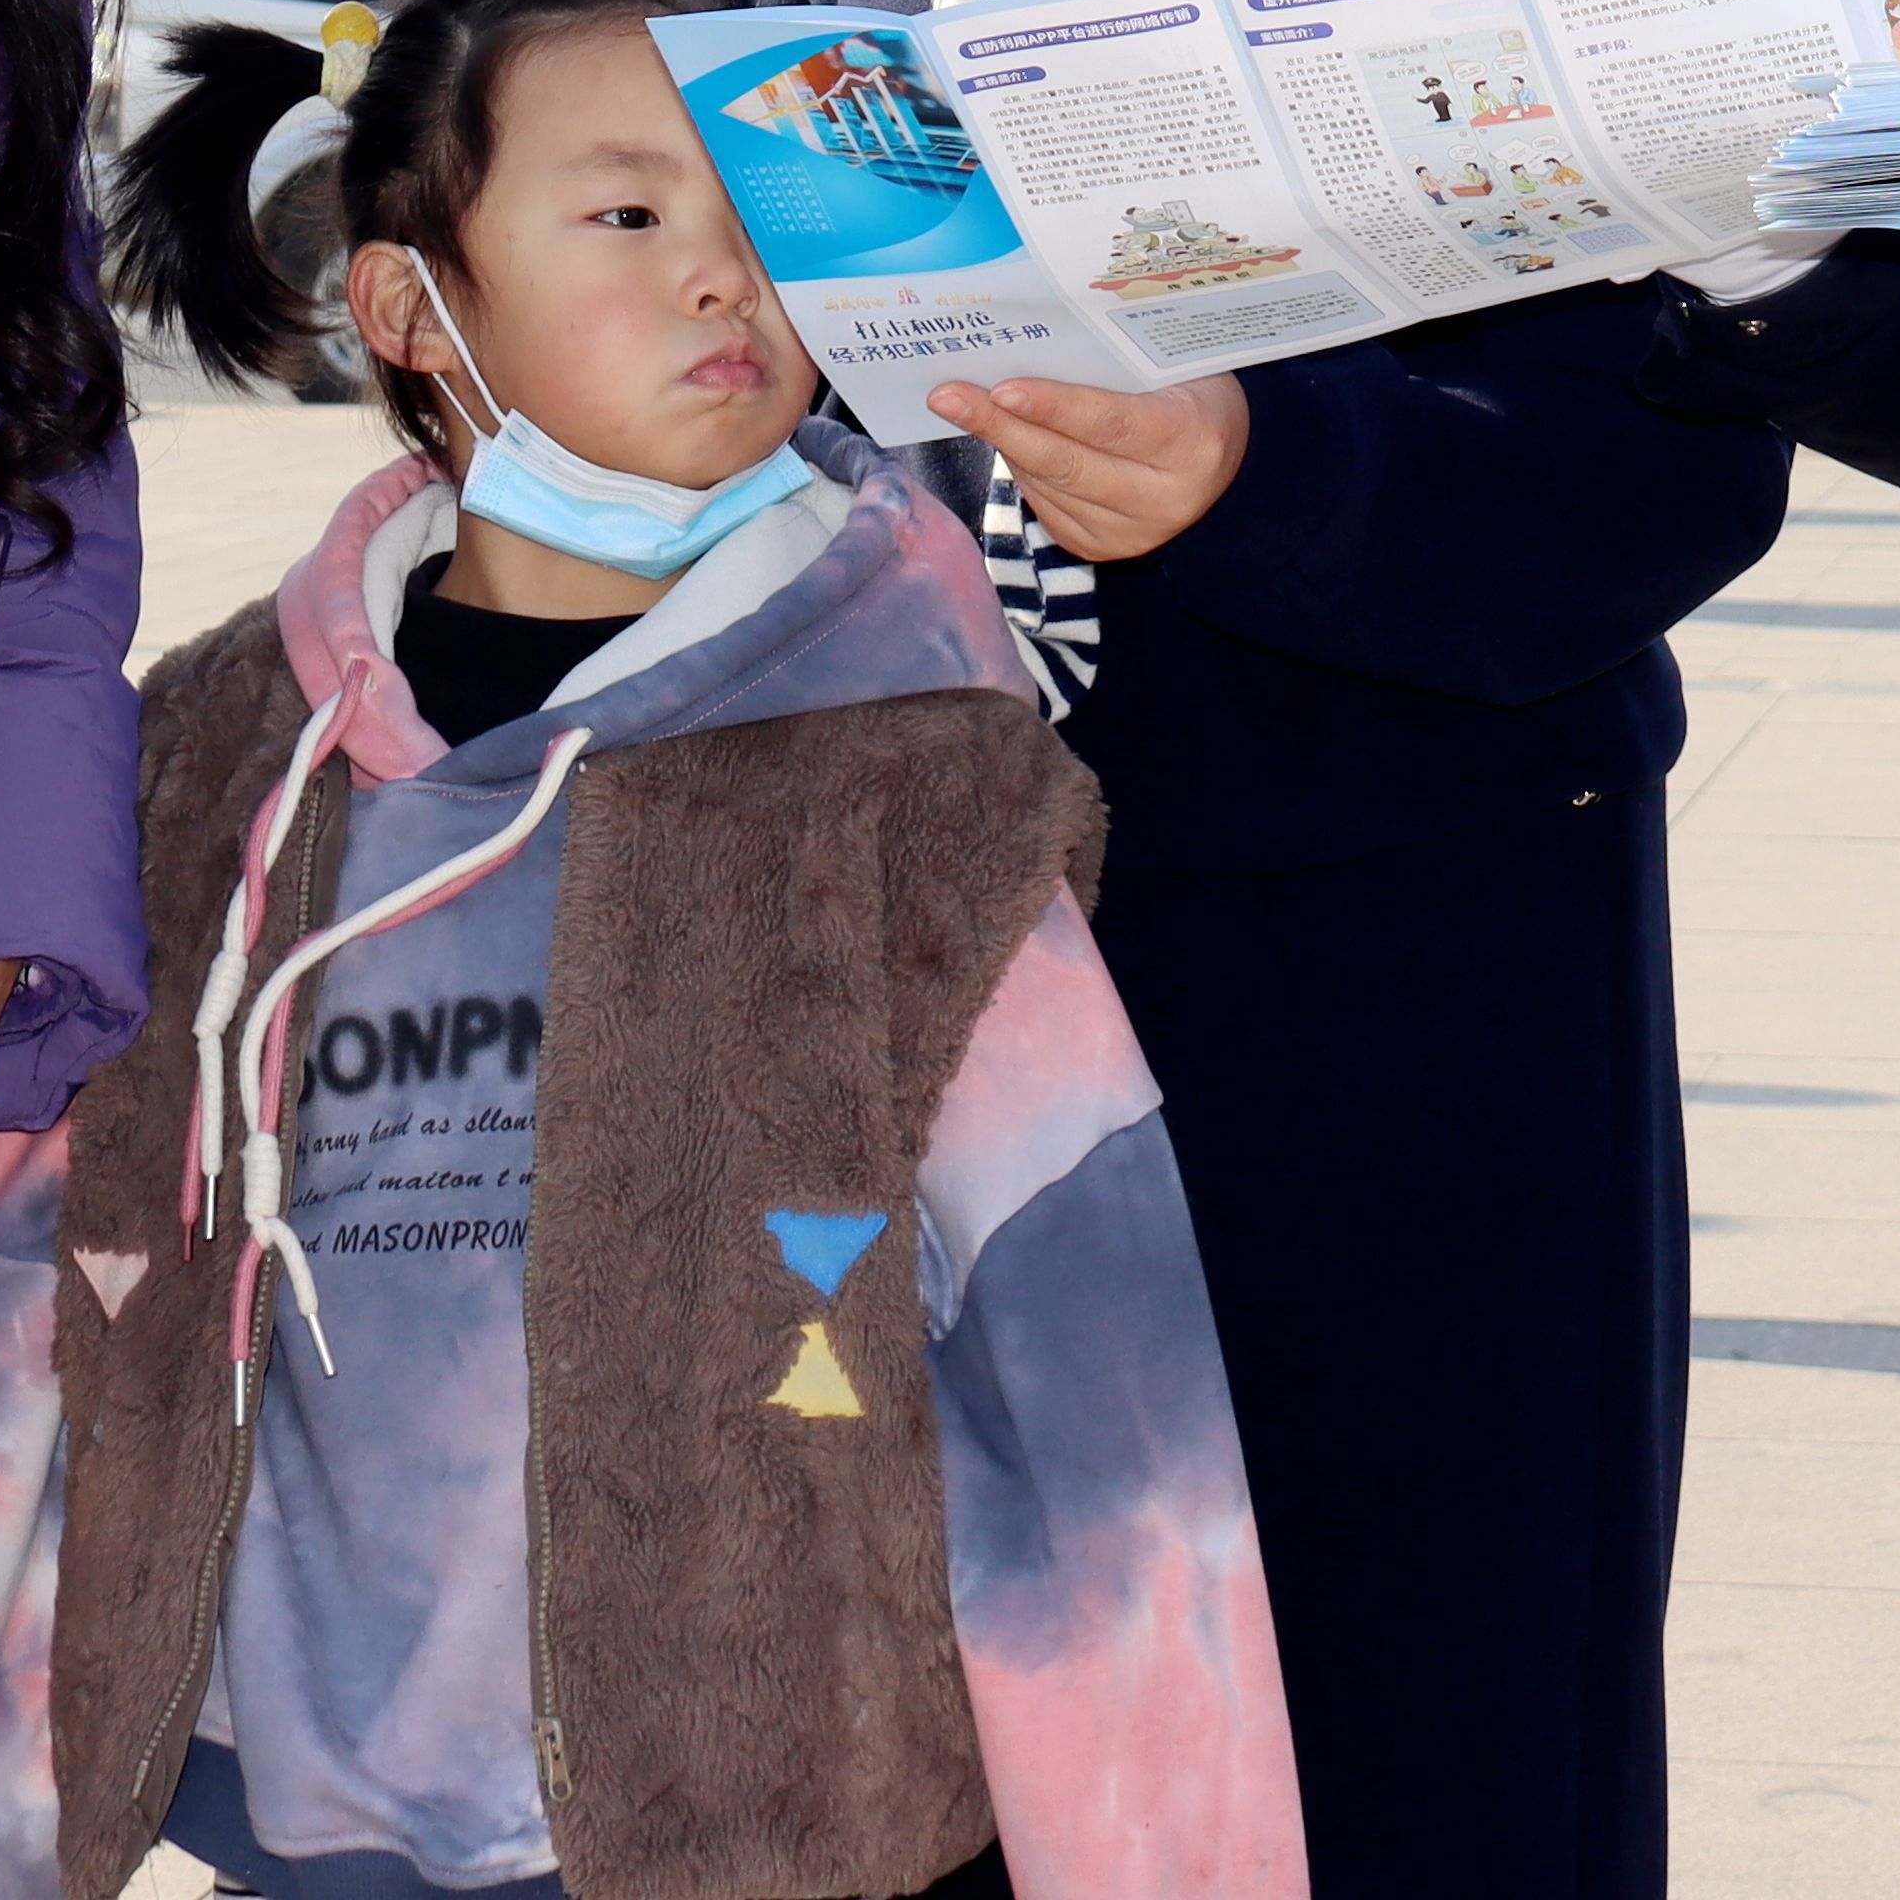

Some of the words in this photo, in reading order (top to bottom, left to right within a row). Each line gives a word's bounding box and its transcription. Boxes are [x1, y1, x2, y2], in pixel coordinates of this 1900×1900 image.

[967, 6, 1192, 57] 谨防利用APP平台进行的网络传销
[827, 322, 1051, 364] 经济犯罪宣传手册
[853, 311, 996, 341] 打击和防范
[298, 996, 541, 1108] ONP
[420, 1118, 451, 1134] as
